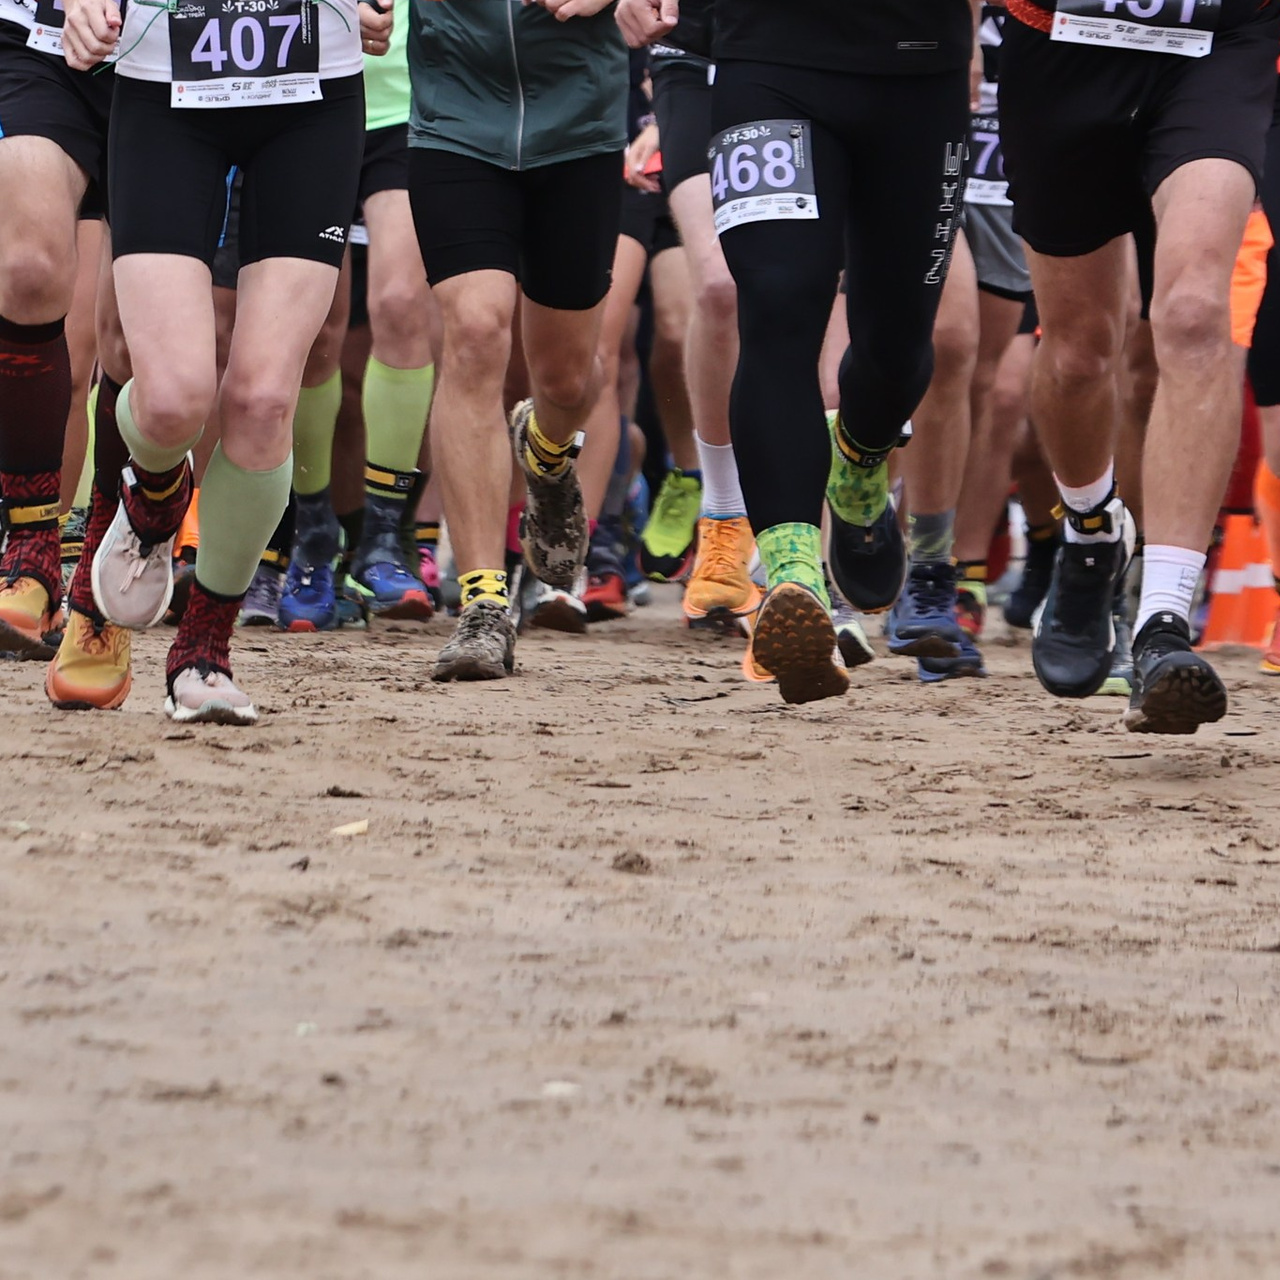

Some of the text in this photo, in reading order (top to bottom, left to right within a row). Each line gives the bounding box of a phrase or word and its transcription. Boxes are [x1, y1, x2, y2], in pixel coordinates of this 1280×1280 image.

[234, 0, 266, 13] T-30
[190, 14, 301, 73] 407
[731, 128, 759, 143] T-30
[712, 140, 796, 201] 468
[924, 141, 964, 285] NIKE
